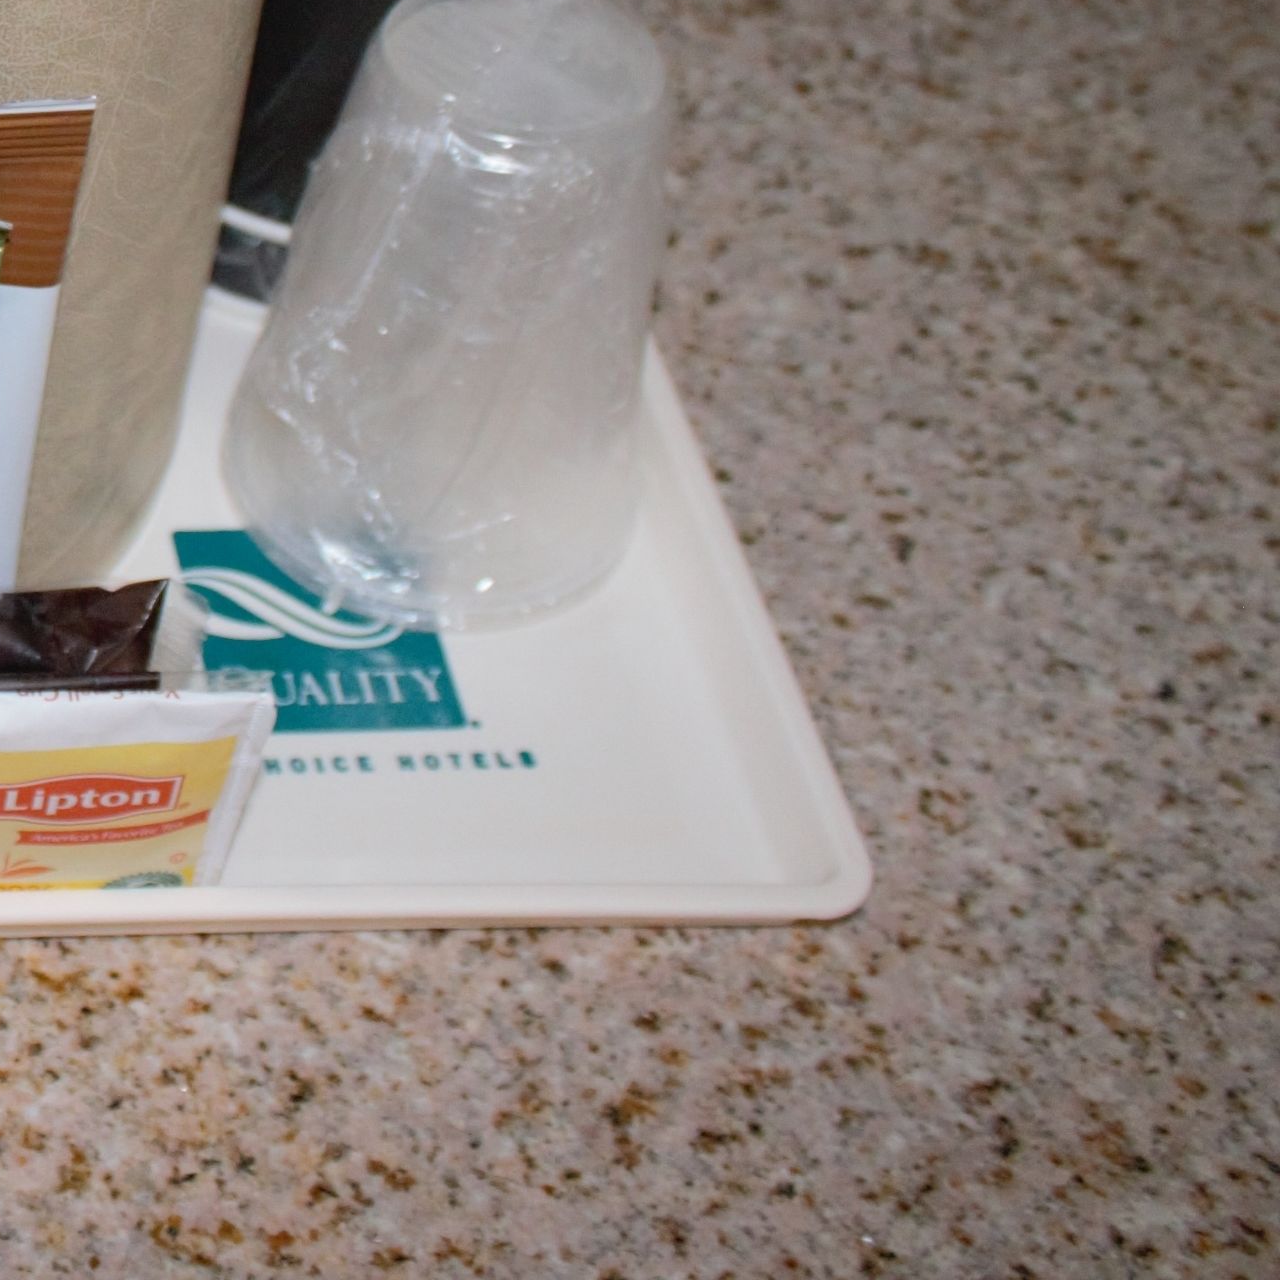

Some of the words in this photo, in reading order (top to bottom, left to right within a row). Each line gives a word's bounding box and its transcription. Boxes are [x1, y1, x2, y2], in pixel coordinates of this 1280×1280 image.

[221, 664, 441, 707] UALITY
[397, 747, 538, 771] HOTELS
[3, 788, 162, 817] Lipton
